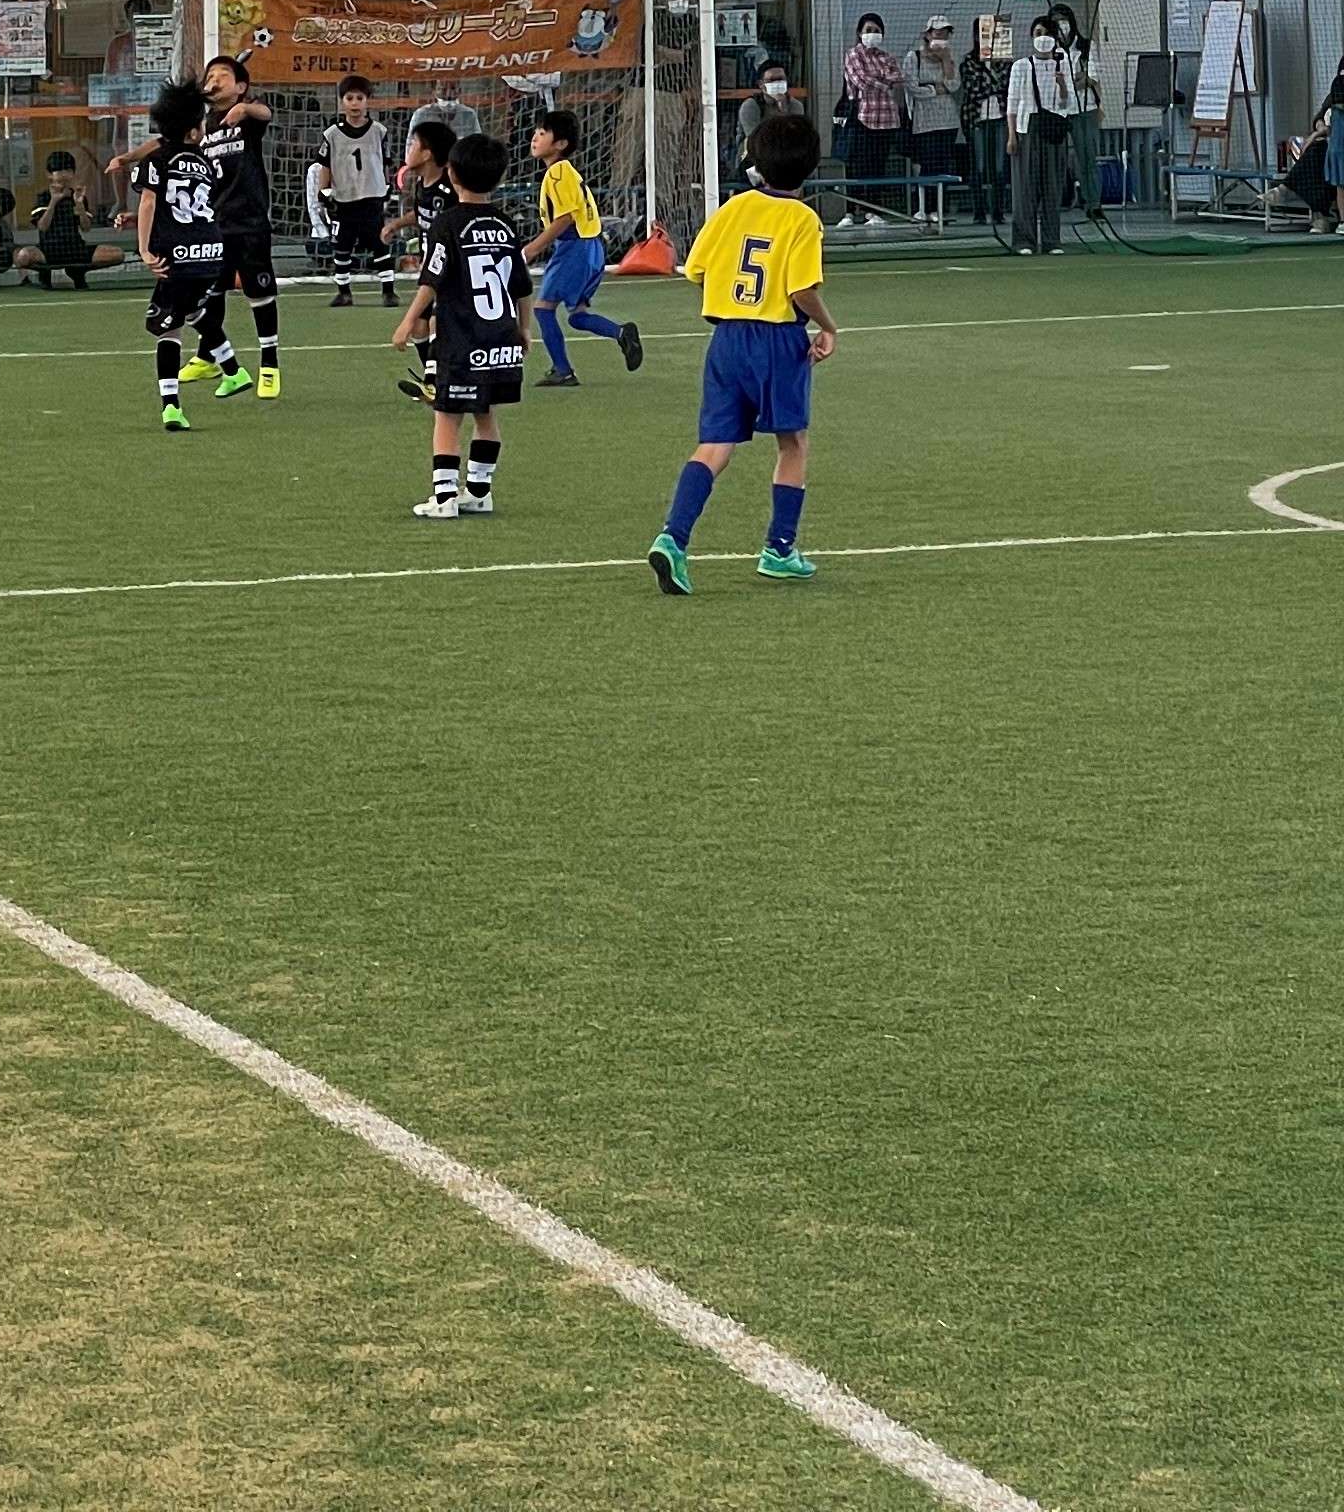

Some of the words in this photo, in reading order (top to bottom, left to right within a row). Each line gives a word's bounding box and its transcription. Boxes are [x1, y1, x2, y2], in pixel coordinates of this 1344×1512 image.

[414, 55, 458, 72] 3RD
[460, 49, 554, 70] PLANET
[352, 148, 362, 171] 1
[471, 229, 508, 244] PIVO
[733, 233, 775, 307] 5
